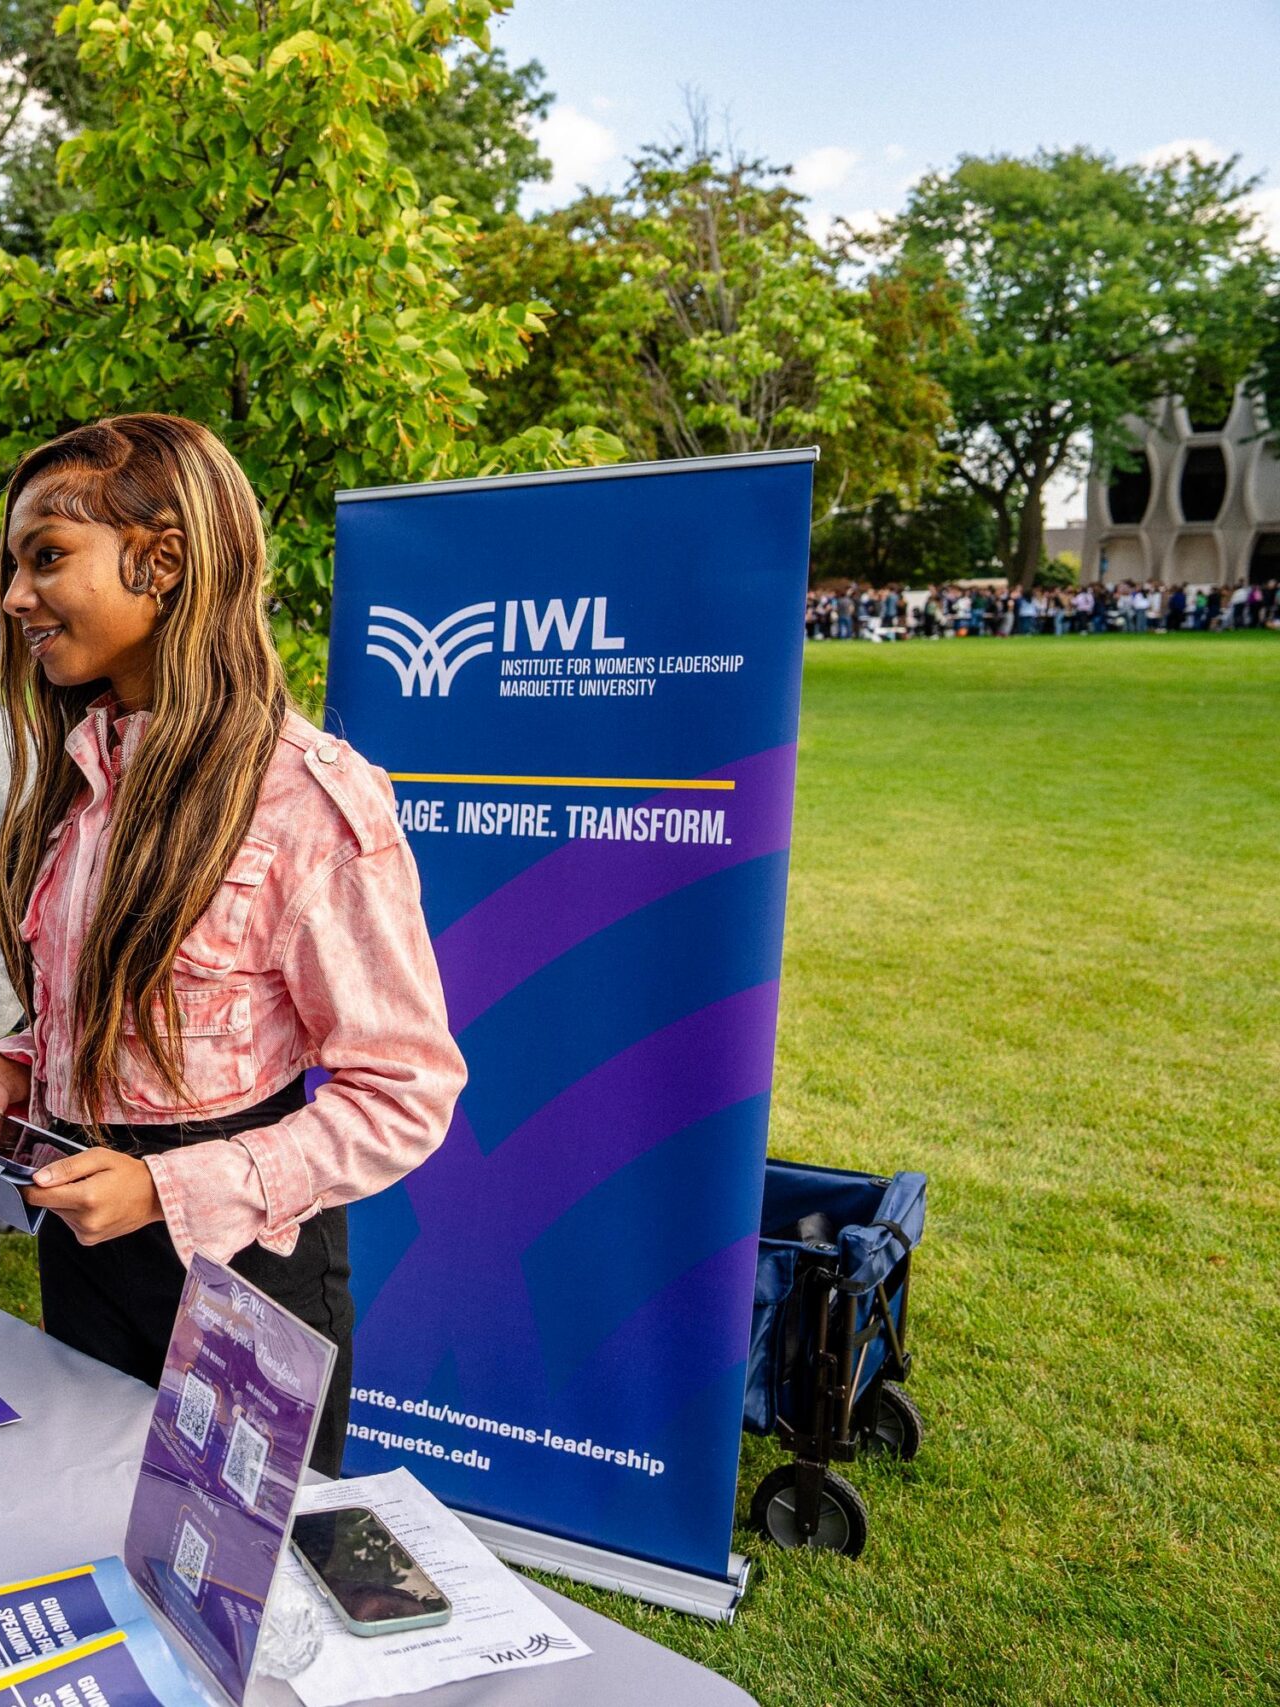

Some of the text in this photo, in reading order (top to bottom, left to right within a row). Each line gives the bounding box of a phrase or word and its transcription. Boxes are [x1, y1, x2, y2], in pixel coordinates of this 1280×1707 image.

[503, 597, 625, 652] IWL
[501, 655, 744, 676] INSTITUTE FOR WOMEN'S LEADERSHIP
[500, 678, 656, 698] MARQUETTE UNIVERSITY
[456, 801, 558, 838] INSPIRE.
[566, 805, 732, 844] TRANSFORM.
[19, 1602, 48, 1640] WORDS
[41, 1596, 70, 1632] GIVING
[480, 1648, 526, 1664] IWL
